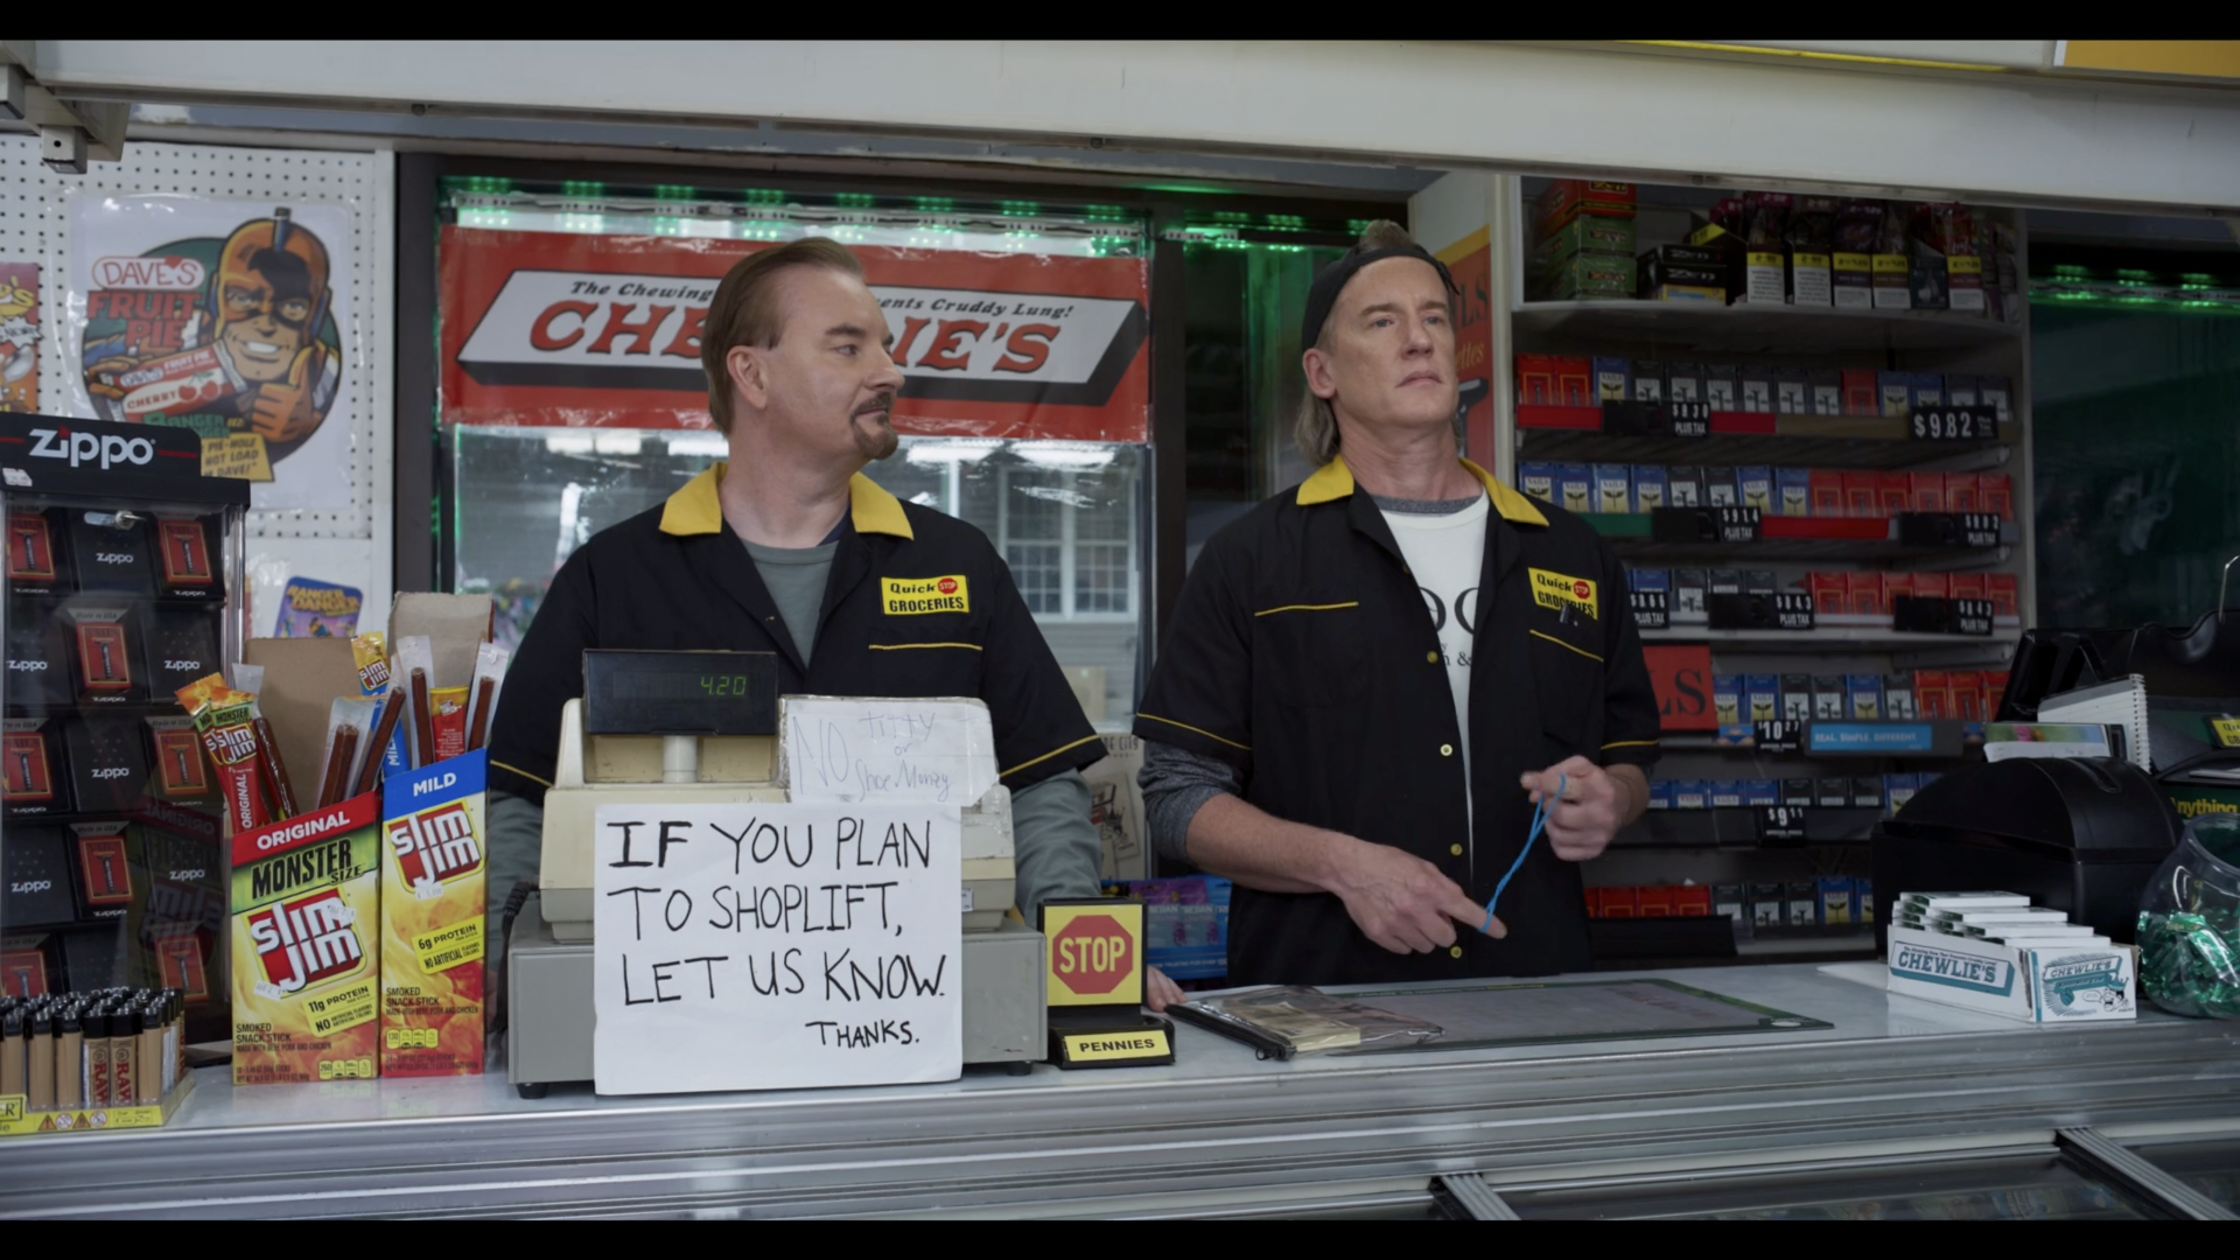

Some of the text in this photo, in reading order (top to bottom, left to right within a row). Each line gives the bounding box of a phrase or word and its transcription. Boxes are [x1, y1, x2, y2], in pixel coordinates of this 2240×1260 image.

[103, 260, 198, 286] DAVE'S
[570, 281, 713, 303] The Chewing
[87, 292, 202, 319] FRUIT
[931, 298, 1007, 317] Cruddy
[1012, 303, 1075, 320] Lung!
[126, 320, 187, 347] PIE
[127, 389, 177, 409] CHERRY
[1674, 422, 1707, 435] PLUS TAX
[890, 582, 956, 595] Quick STOP
[1537, 573, 1590, 596] Quick STOP
[889, 596, 964, 612] GROCERIES
[104, 612, 118, 620] USA
[1652, 613, 1665, 625] TAX
[1779, 613, 1810, 626] PLUS TAX
[216, 706, 248, 724] MONSTER
[793, 716, 849, 795] NO
[894, 742, 912, 756] or
[413, 772, 457, 797] MILD
[236, 773, 253, 829] ORIGINAL
[104, 824, 118, 832] USA
[256, 811, 350, 850] ORIGINAL
[607, 817, 931, 875] IF YOU PLAN
[252, 839, 352, 900] MONSTER
[330, 864, 363, 884] SIZE
[607, 882, 903, 941] TO SHOPLIFT,
[418, 923, 477, 950] 6g PROTEIN
[424, 947, 463, 970] NO ARTIFICIAL
[1060, 935, 1125, 973] STOP
[622, 948, 947, 1006] LET US KNOW.
[1898, 950, 1996, 983] CHEWLIE'S
[2051, 960, 2112, 978] CHEWLIE'S
[308, 985, 368, 1013] 11g PROTEIN
[386, 986, 421, 997] SMOKED
[386, 996, 440, 1007] SNACK STICK
[456, 1005, 479, 1014] CHICKEN
[235, 1022, 272, 1033] SMOKED
[315, 1018, 331, 1033] NO
[805, 1019, 920, 1048] THANKS.
[235, 1033, 292, 1044] SNACK STICK
[297, 1043, 308, 1051] AND
[308, 1041, 332, 1051] CHICKEN
[1080, 1039, 1155, 1052] PENNIES
[320, 1063, 331, 1071] 260
[94, 1062, 108, 1104] RAW
[117, 1061, 132, 1104] RAW
